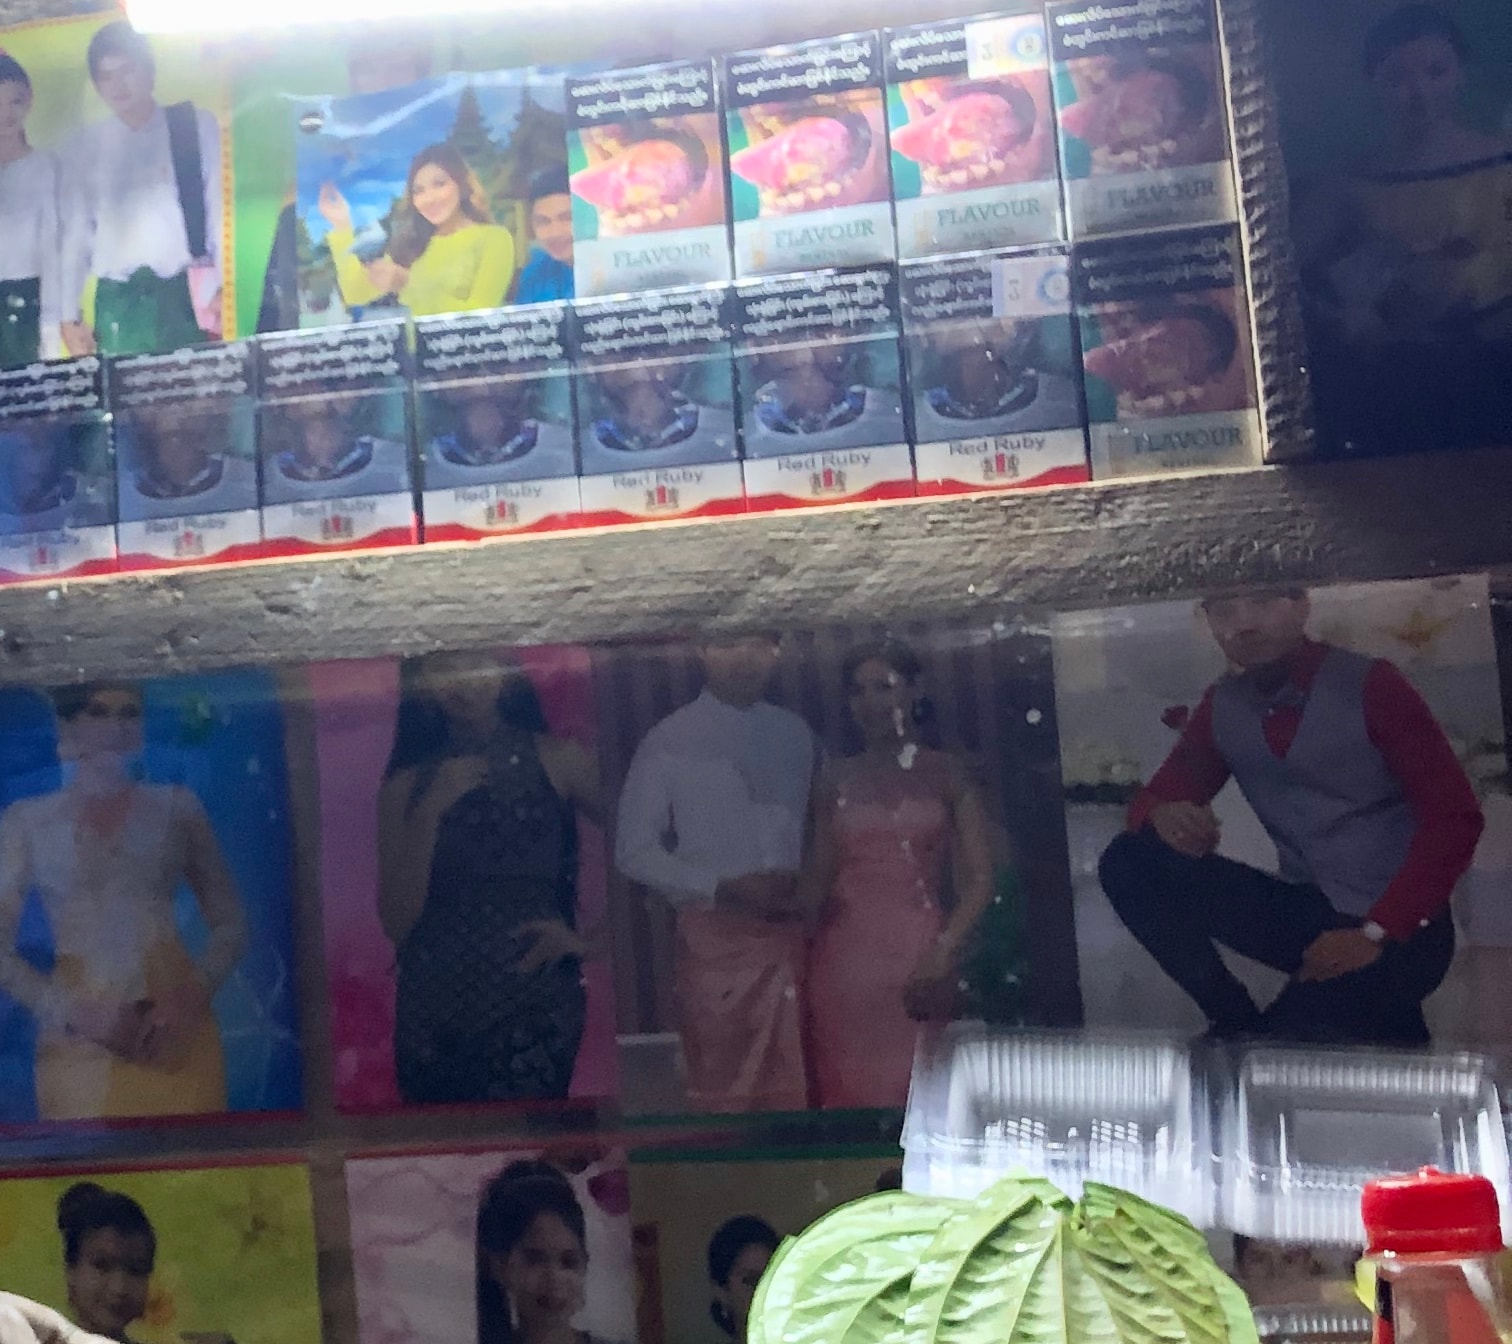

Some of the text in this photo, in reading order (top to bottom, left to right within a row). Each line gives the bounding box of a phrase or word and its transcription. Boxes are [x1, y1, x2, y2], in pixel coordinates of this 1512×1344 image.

[1107, 179, 1217, 210] FLAVOUR
[938, 197, 1041, 228] FLAVOUR
[773, 219, 876, 249] FLAVOUR
[612, 241, 712, 269] FLAVOUR
[949, 434, 1047, 457] Red Ruby
[1134, 427, 1245, 455] FLAVOUR
[777, 451, 872, 472] Red Ruby
[612, 468, 704, 489] Red Ruby
[453, 483, 542, 503] Red Ruby
